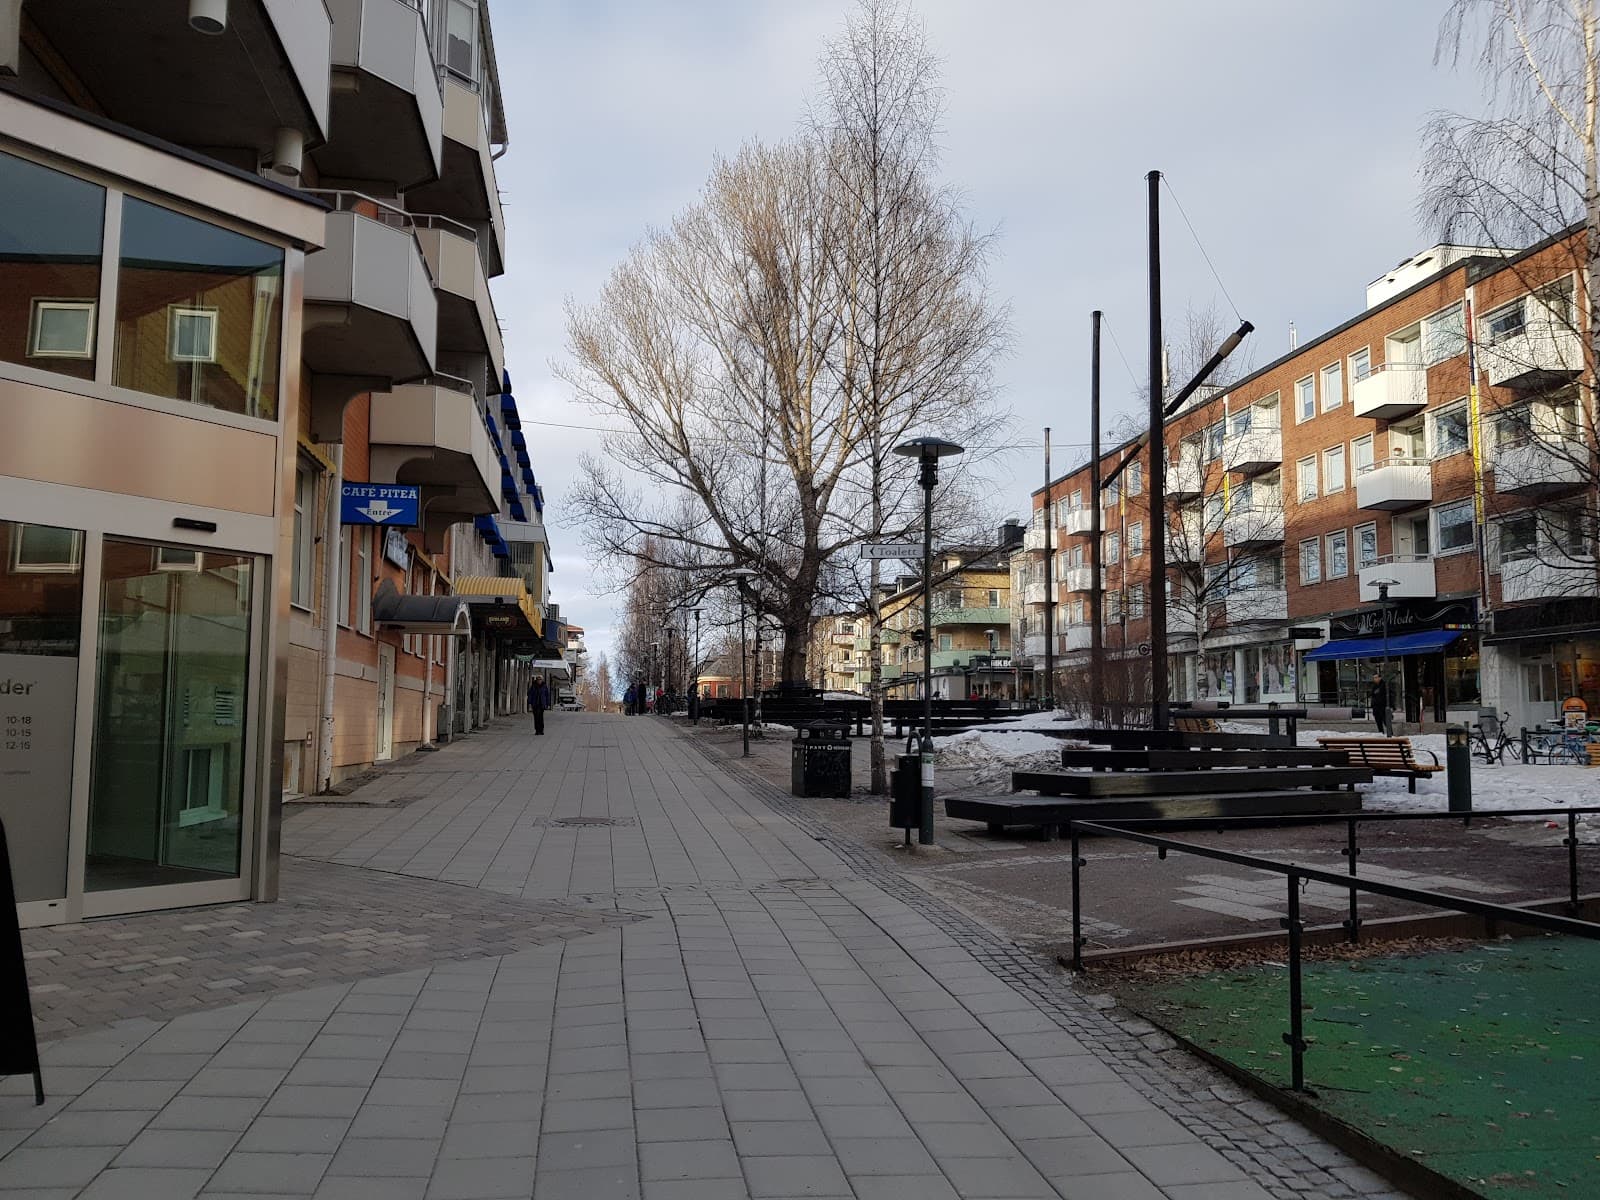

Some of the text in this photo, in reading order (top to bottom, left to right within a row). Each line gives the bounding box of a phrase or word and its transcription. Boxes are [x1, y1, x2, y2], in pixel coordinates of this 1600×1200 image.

[342, 485, 417, 499] CAFÉ PITEÅ
[878, 546, 917, 556] Toalett
[6, 716, 31, 724] 10-18
